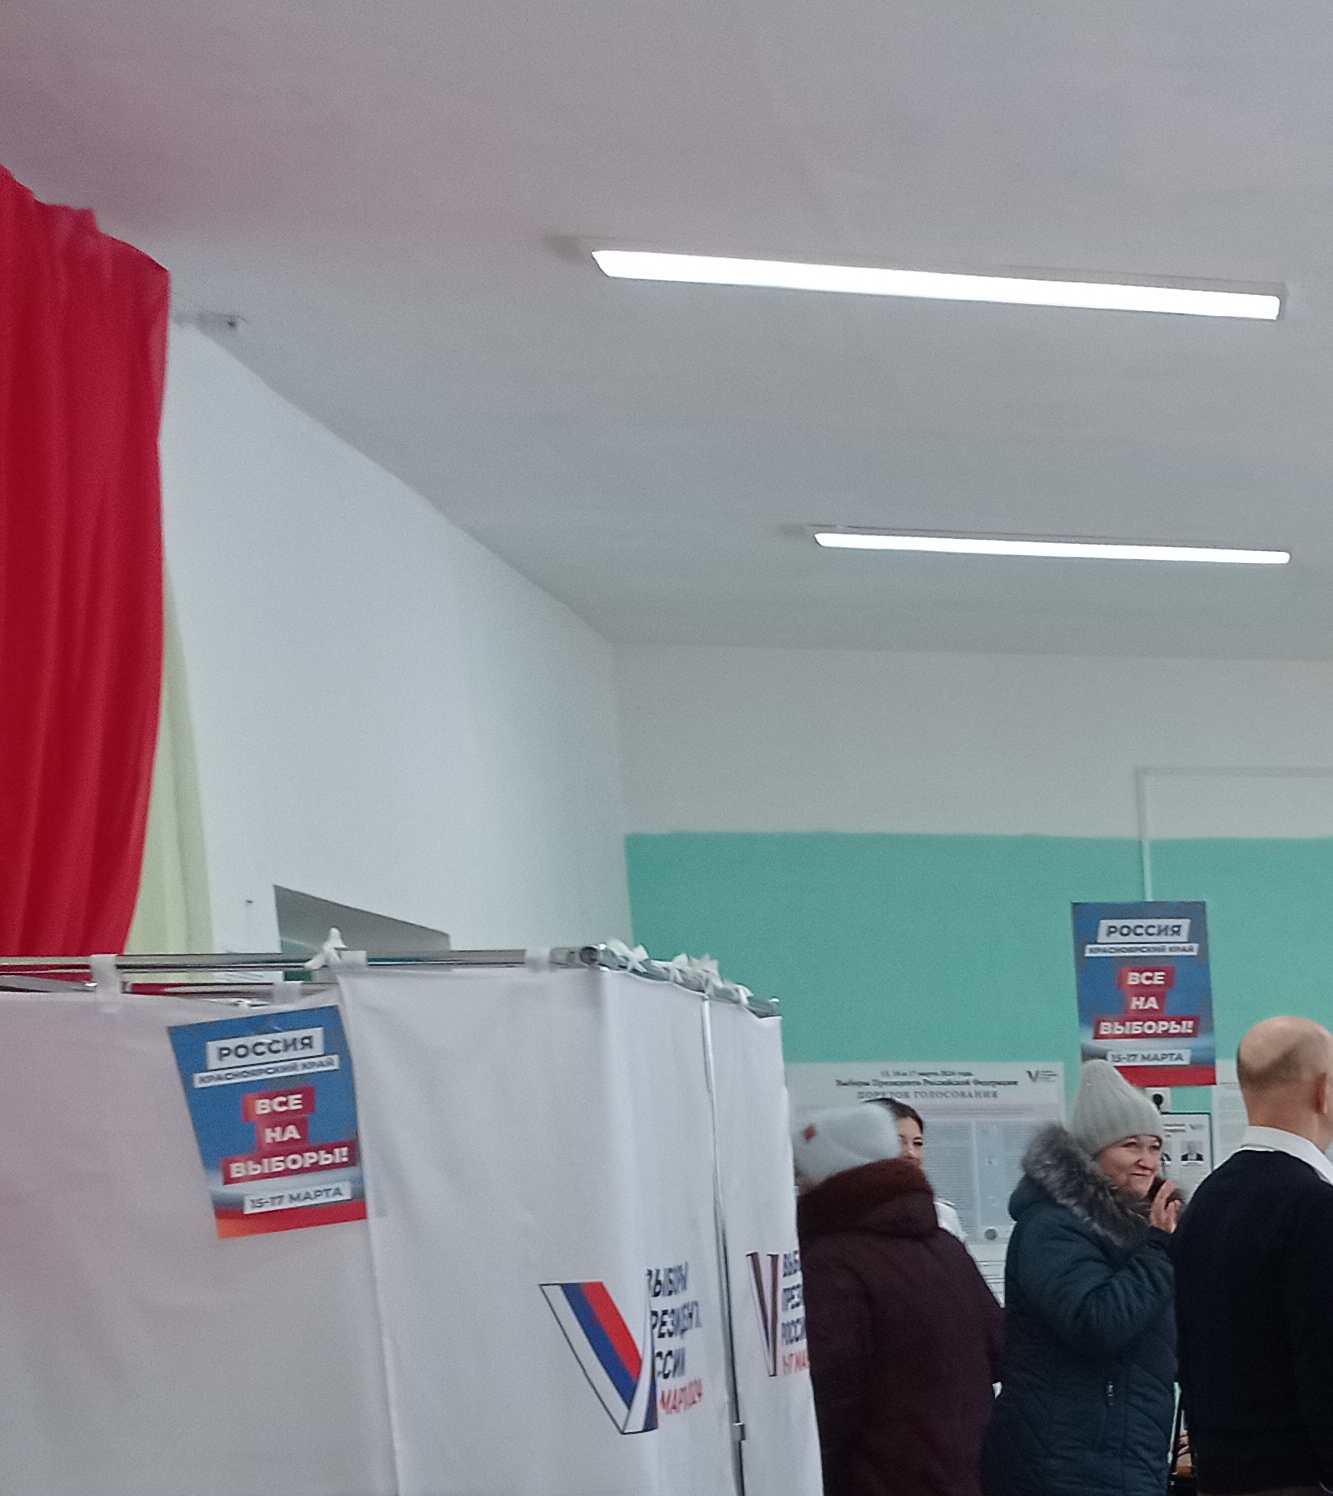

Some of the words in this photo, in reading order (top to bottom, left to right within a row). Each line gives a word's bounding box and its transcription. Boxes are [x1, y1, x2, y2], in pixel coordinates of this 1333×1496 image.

[1106, 924, 1182, 938] РОССИЯ
[1126, 971, 1166, 986] ВСЕ
[1130, 996, 1159, 1010] НА
[1098, 1020, 1194, 1035] ВЫБОРЫ!
[217, 1034, 314, 1062] РОССИЯ
[1142, 1052, 1184, 1062] МАРТА
[255, 1094, 303, 1115] ВСЕ
[264, 1124, 301, 1143] НА
[229, 1147, 349, 1179] ВЫБОРЫ!
[288, 1187, 343, 1202] МАРТА
